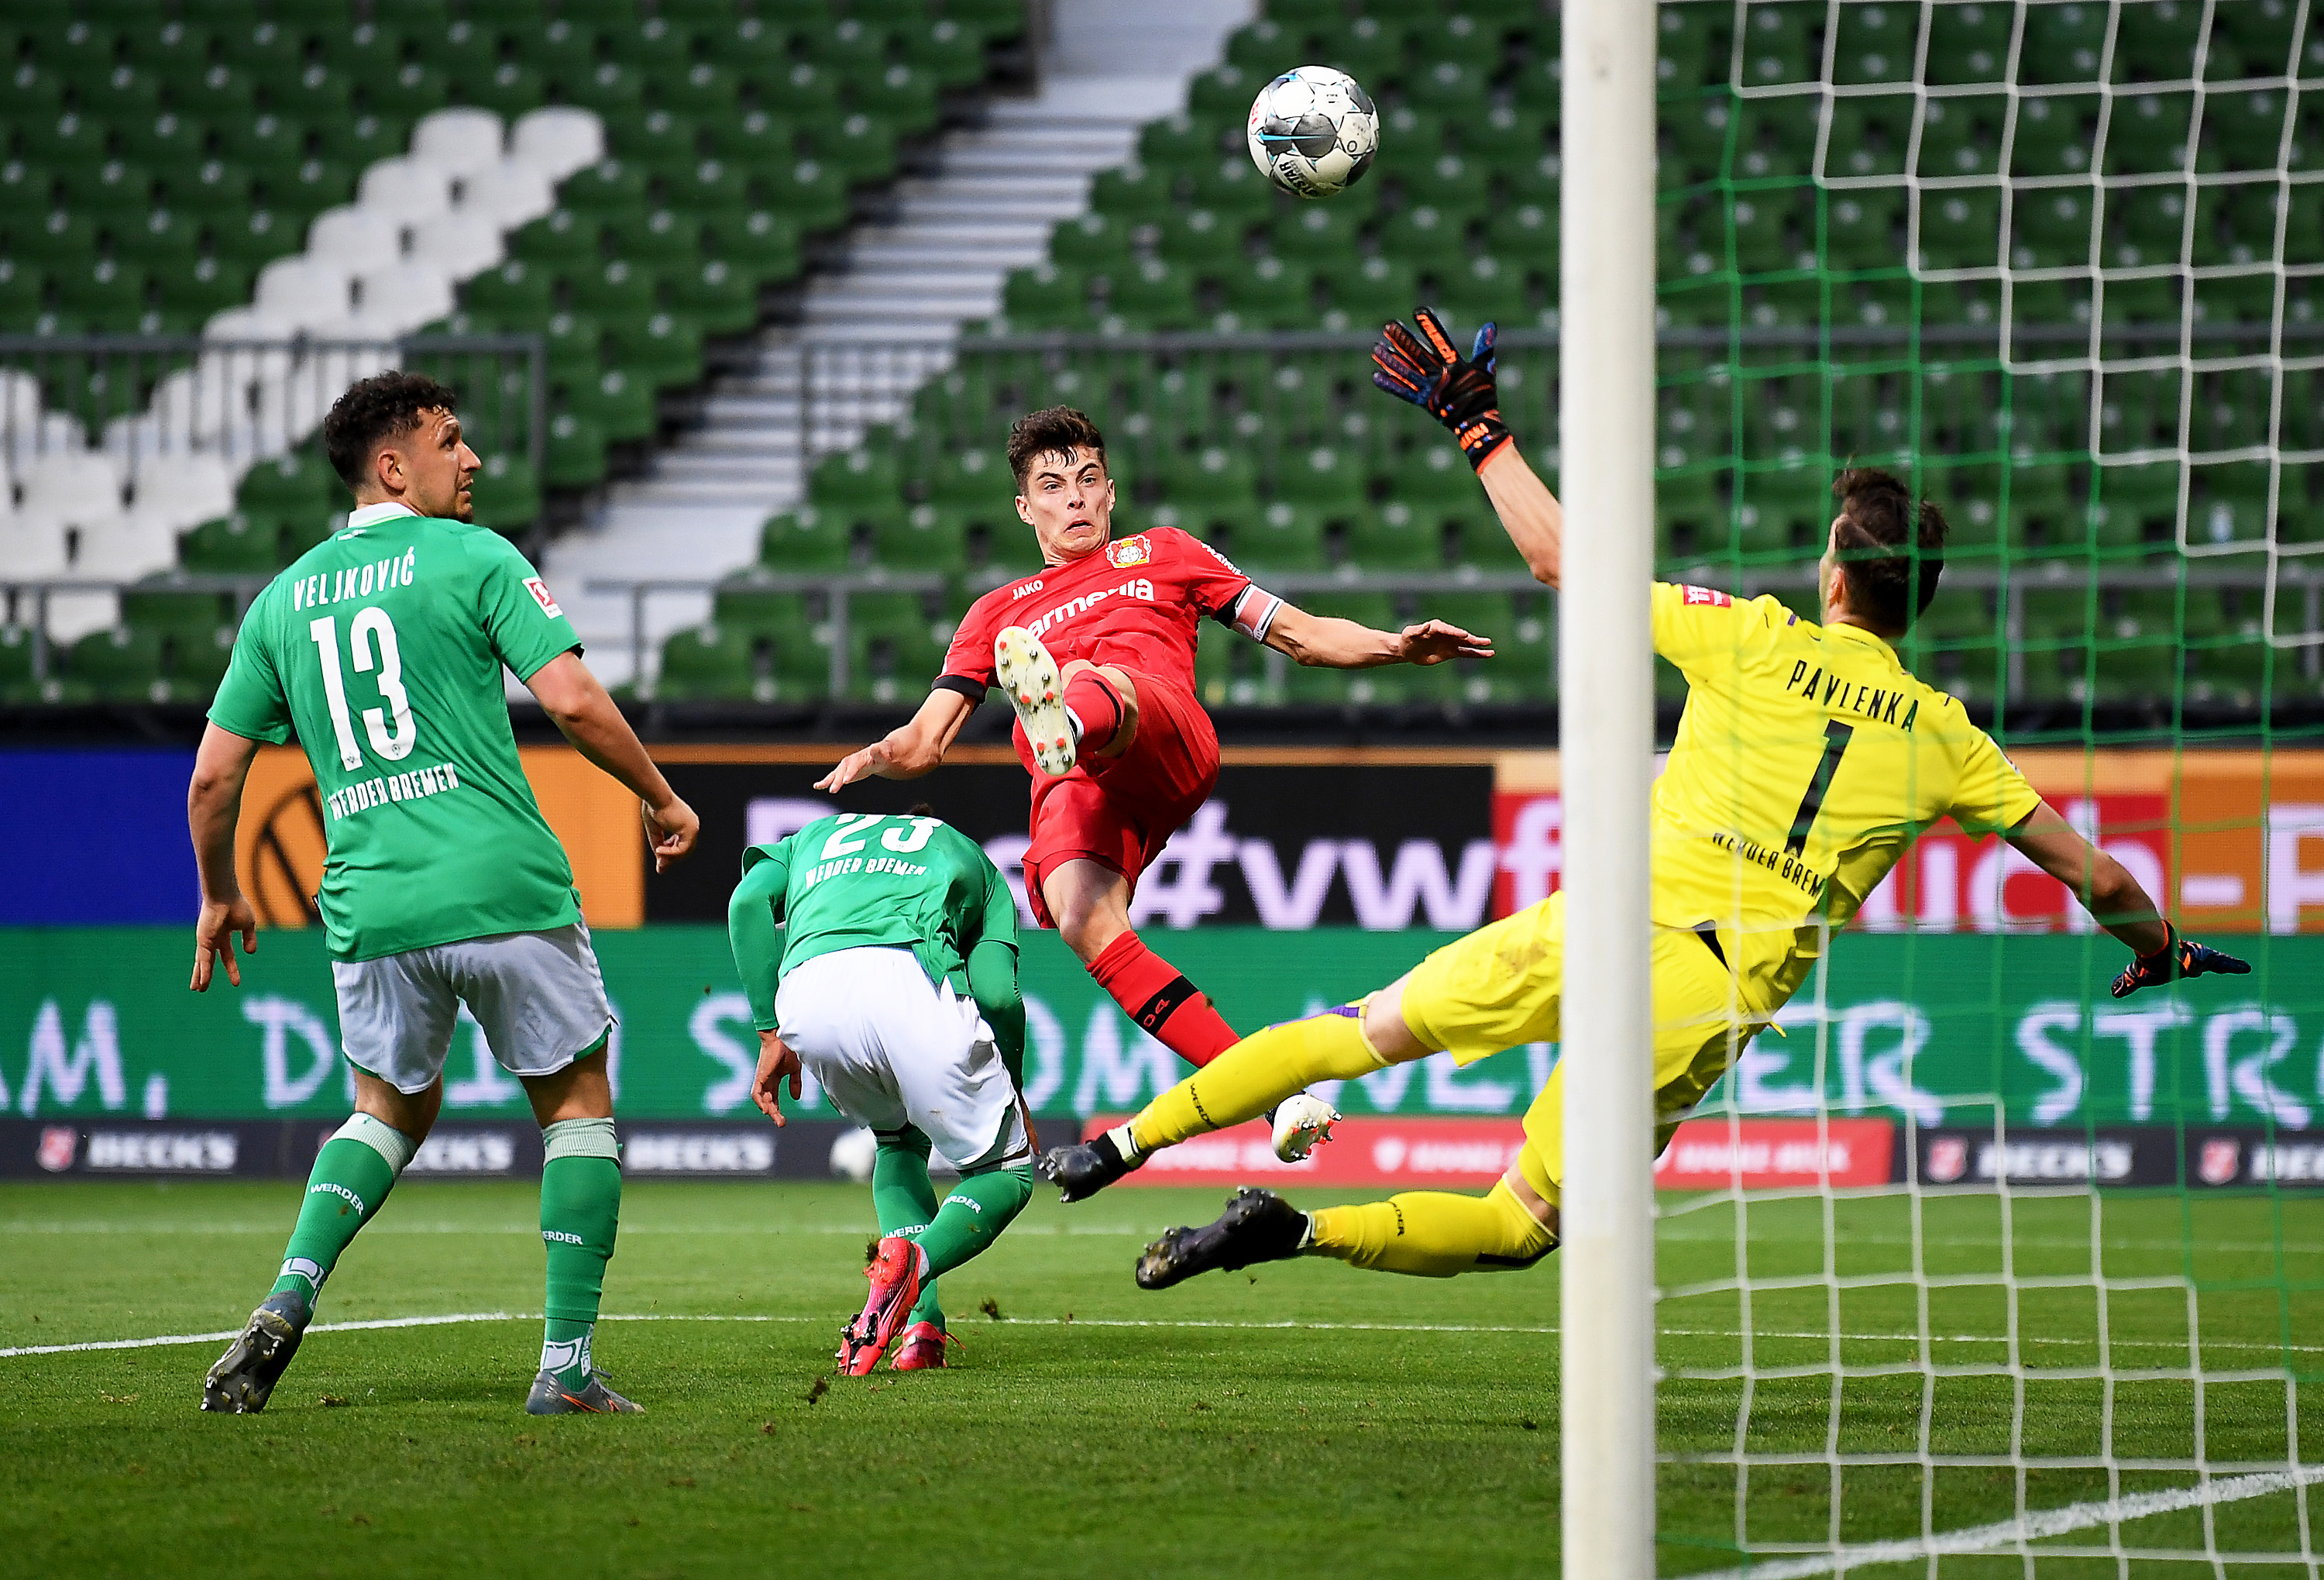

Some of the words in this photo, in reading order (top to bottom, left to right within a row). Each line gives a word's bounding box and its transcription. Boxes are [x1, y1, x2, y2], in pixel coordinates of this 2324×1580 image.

[294, 546, 416, 612] VELJKOVIĆ
[1012, 580, 1044, 601] JAKO
[1026, 578, 1154, 640] armenia
[309, 606, 417, 772] 13
[1786, 659, 1920, 734] PAVLENKA
[327, 777, 388, 821] WERDER
[390, 762, 460, 804] BREMEN
[1783, 718, 1855, 859] 1
[805, 857, 863, 890] WERDER
[1781, 857, 1825, 899] BREM
[2014, 1000, 2324, 1131] STR
[1190, 1082, 1221, 1129] WERD
[310, 1182, 364, 1216] WERDER
[542, 1231, 583, 1245] ERDER
[885, 1224, 930, 1239] WERD
